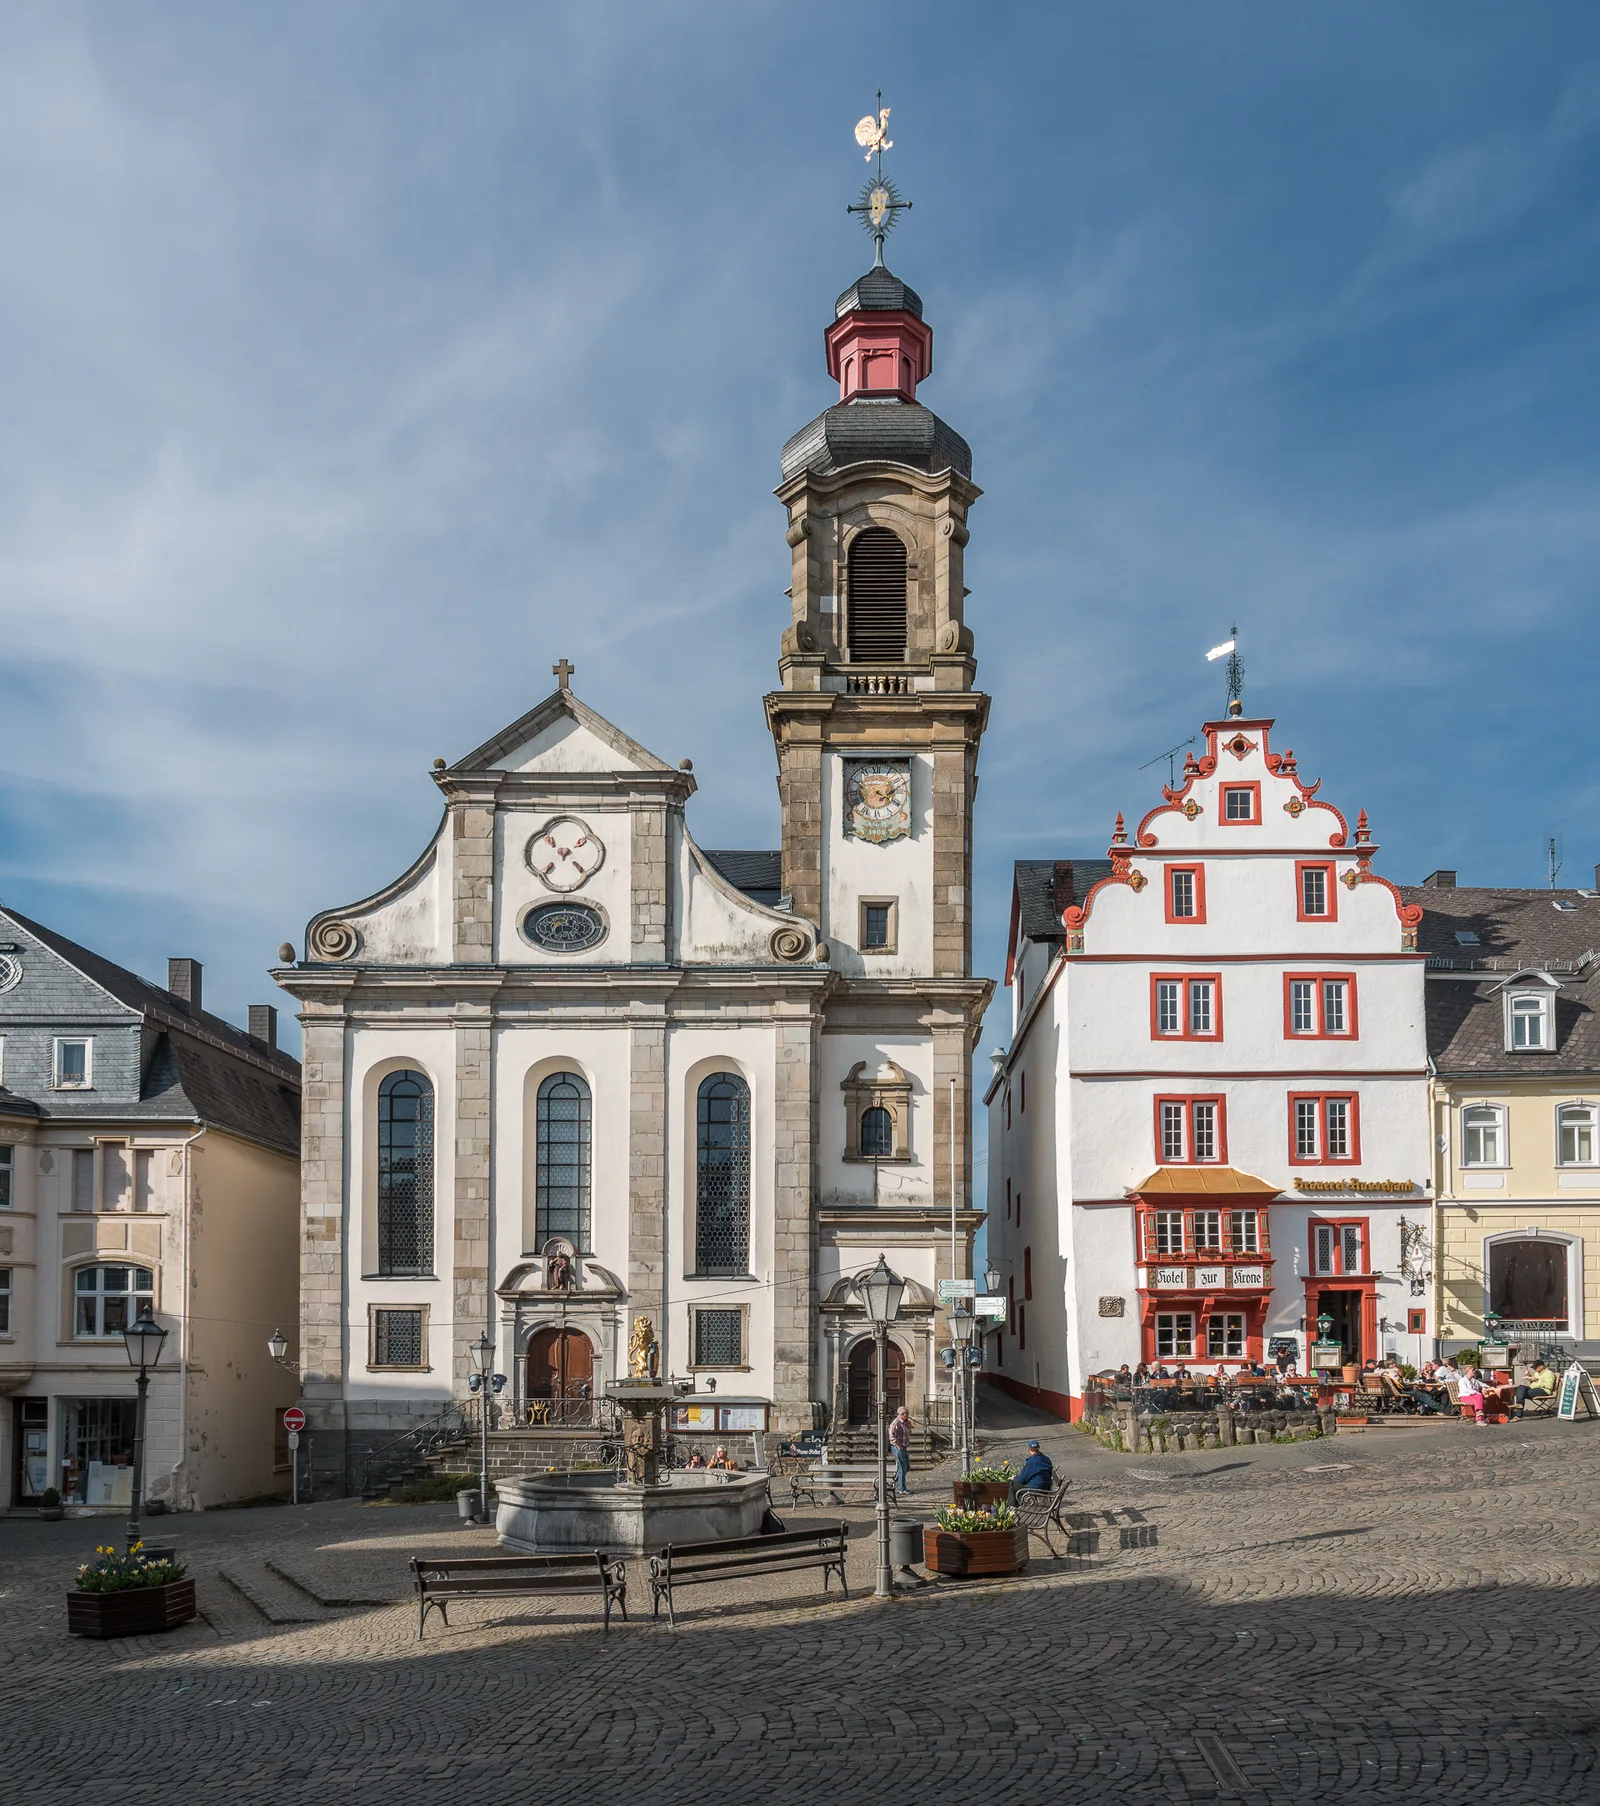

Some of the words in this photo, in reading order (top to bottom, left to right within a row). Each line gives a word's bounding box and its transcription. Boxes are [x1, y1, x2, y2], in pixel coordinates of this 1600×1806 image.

[1157, 1270, 1185, 1284] Hotel
[1201, 1273, 1218, 1285] zur
[1234, 1270, 1262, 1284] Krone
